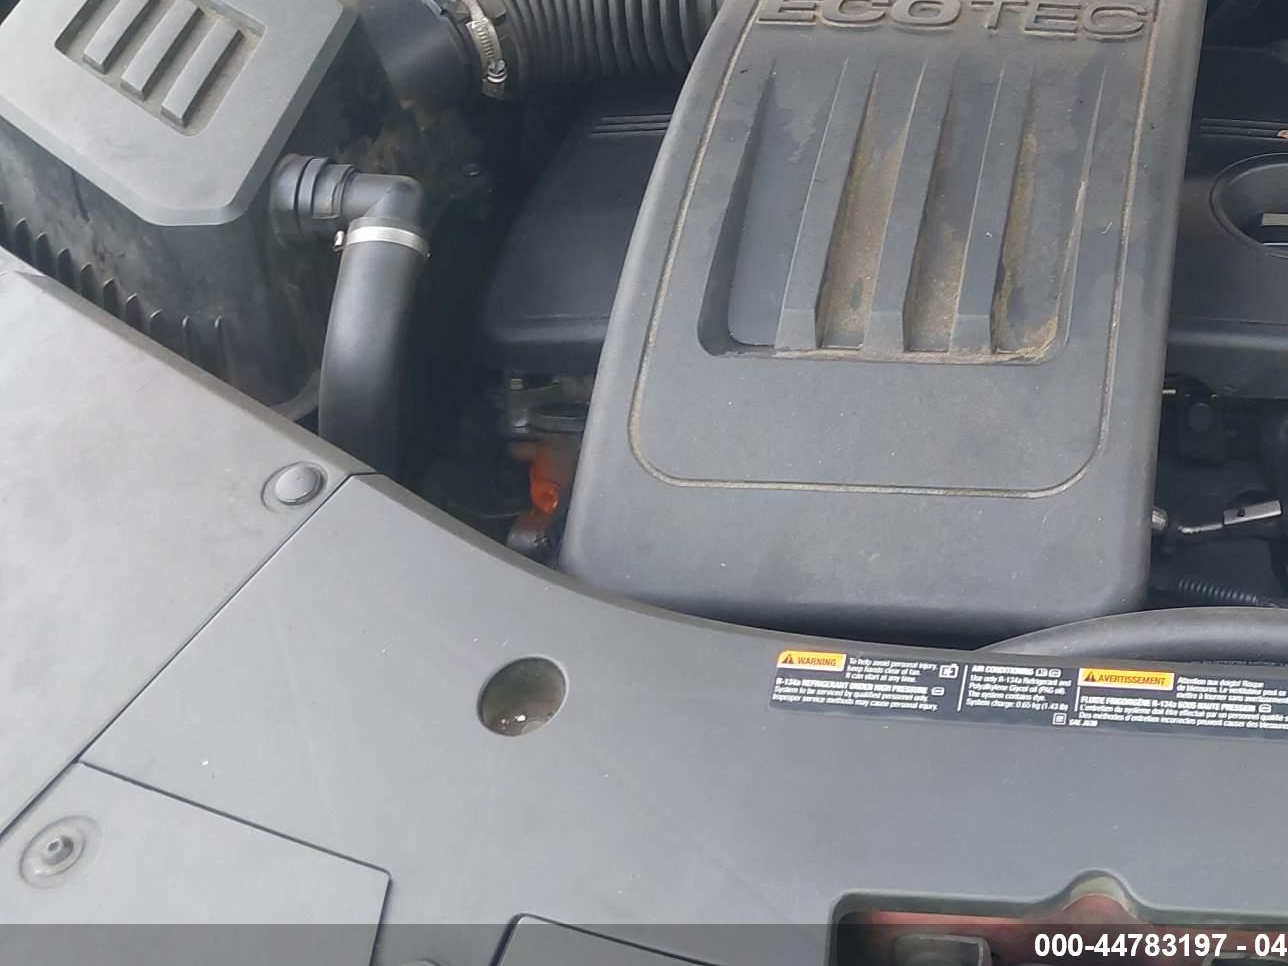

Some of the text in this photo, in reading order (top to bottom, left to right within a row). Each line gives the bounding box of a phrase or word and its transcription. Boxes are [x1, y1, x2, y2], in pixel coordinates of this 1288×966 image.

[798, 656, 836, 666] WARNING
[858, 658, 872, 666] help
[890, 661, 919, 669] personal
[985, 666, 1034, 676] CONDITIONING
[998, 676, 1023, 684] R-134a
[1022, 677, 1058, 686] Refrigerant
[1059, 679, 1072, 687] and
[1098, 674, 1166, 685] AVERTISSEMENT
[1177, 676, 1206, 685] Attention
[776, 677, 801, 686] R-134a
[801, 678, 849, 690] REFRIGERANT
[874, 684, 892, 692] HIGH
[892, 684, 928, 694] PRESSURE
[1009, 684, 1030, 693] Glycol
[1030, 685, 1038, 693] oil
[774, 686, 798, 694] System
[816, 688, 844, 696] serviced
[844, 690, 854, 698] by
[853, 691, 882, 699] qualified
[968, 690, 981, 698] The
[1228, 687, 1262, 696] ventilateur
[772, 694, 802, 702] Improper
[826, 697, 855, 705] methods
[854, 699, 870, 708] may
[890, 701, 919, 709] personal
[966, 698, 990, 706] System
[1032, 702, 1041, 710] kg
[1080, 696, 1106, 704] FLUIDE
[1152, 700, 1177, 708] R-134a
[1177, 701, 1197, 710] SOUS
[1197, 702, 1220, 710] HAUTE
[1220, 704, 1256, 712] PRESSION
